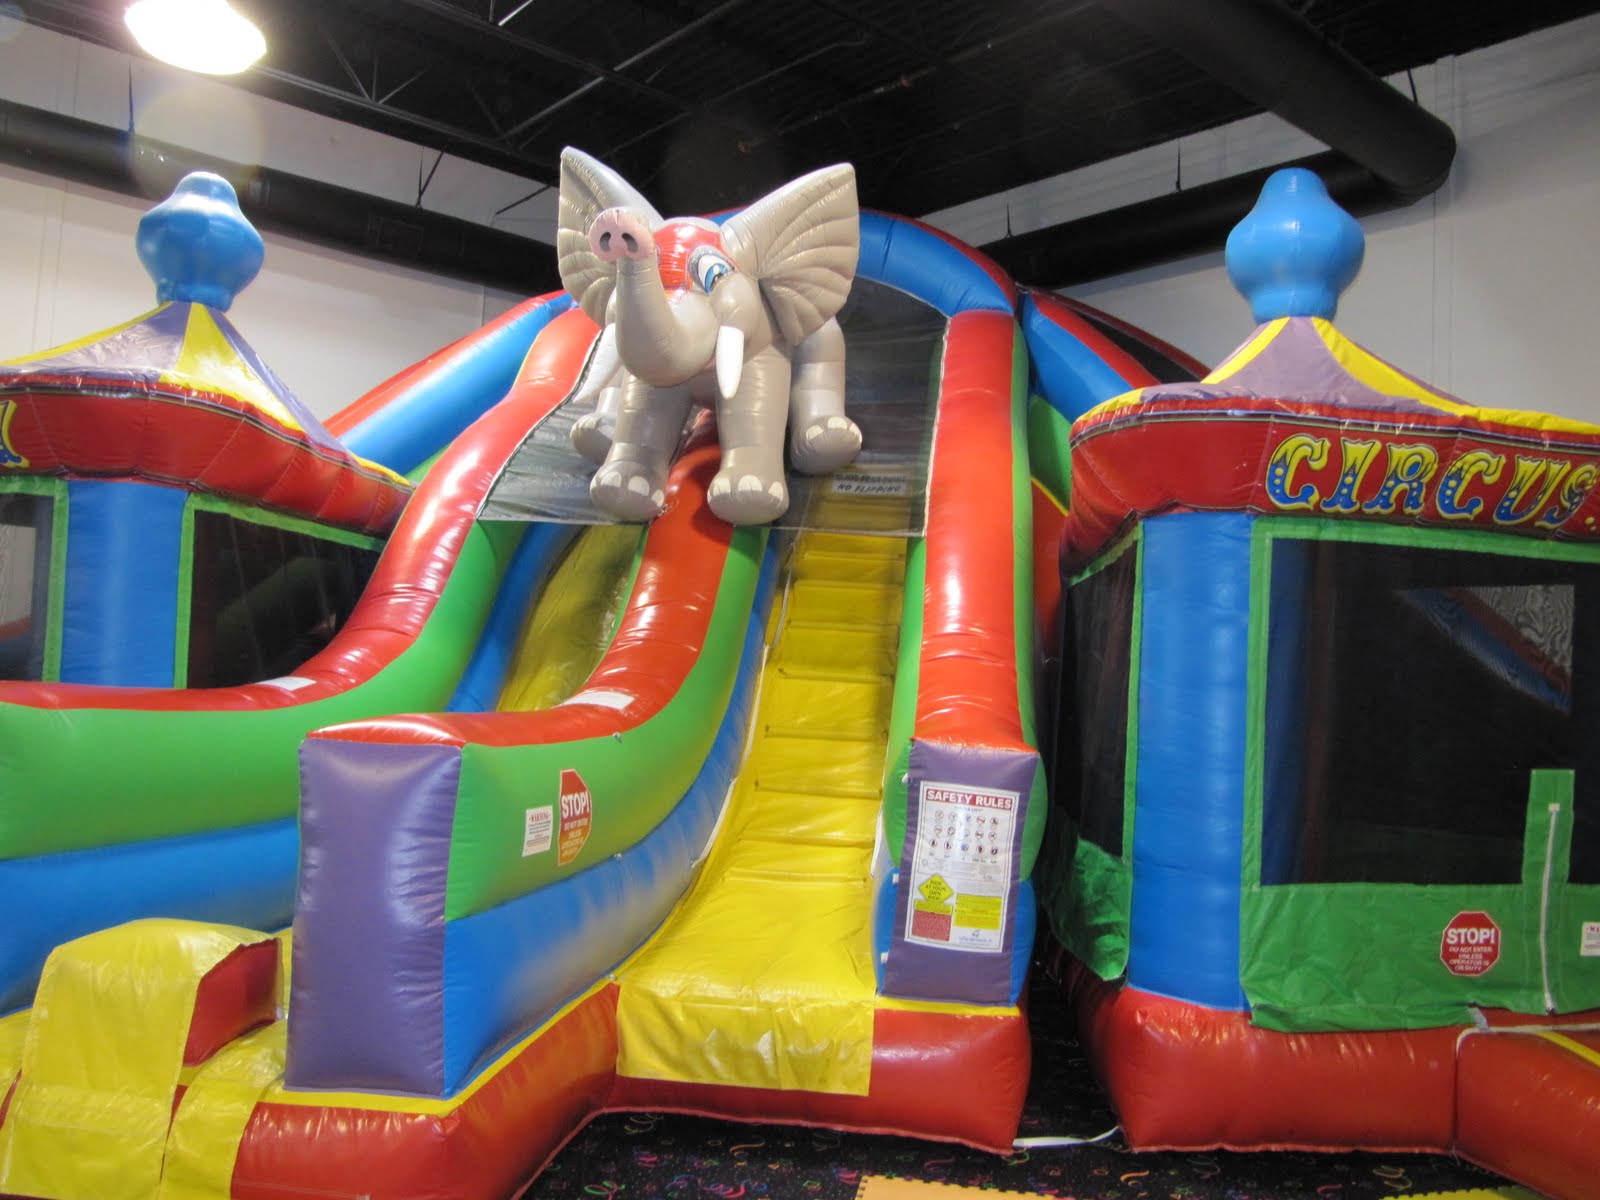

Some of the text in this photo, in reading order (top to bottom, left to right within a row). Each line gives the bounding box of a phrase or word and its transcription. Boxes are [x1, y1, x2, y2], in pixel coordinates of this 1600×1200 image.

[837, 483, 901, 493] NO FLIPPING
[1265, 433, 1599, 529] CIRCUS
[561, 791, 590, 819] STOP!
[927, 790, 973, 805] SAFETY
[975, 797, 1012, 809] RULES
[1446, 927, 1496, 945] STOP!
